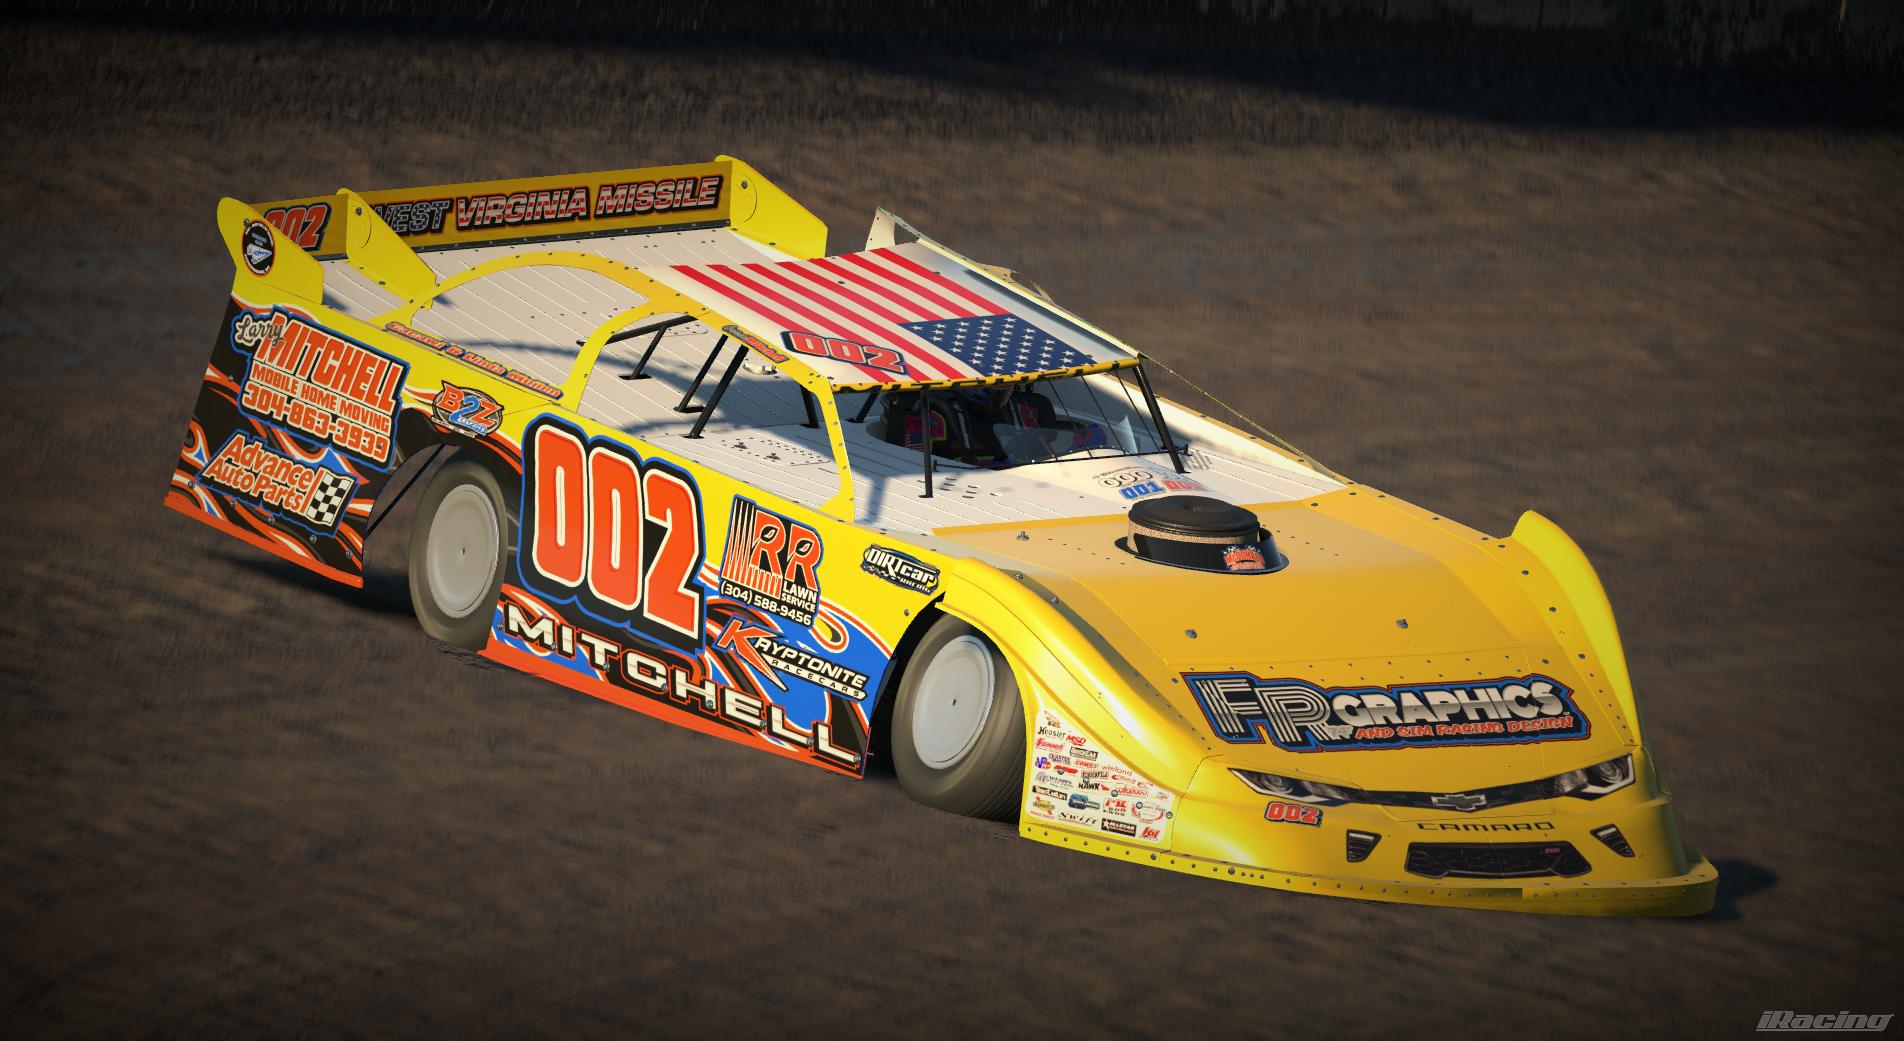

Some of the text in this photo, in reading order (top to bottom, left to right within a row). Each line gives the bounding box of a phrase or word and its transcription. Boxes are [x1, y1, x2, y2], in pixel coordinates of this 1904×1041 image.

[457, 189, 587, 228] VIRGINIA
[595, 177, 719, 215] MISSILE
[236, 315, 285, 347] Larry
[788, 331, 906, 375] 002
[254, 313, 405, 414] MITCHELL
[251, 362, 299, 397] MOBILE
[300, 378, 339, 413] HOME
[339, 391, 392, 434] MOVING
[436, 382, 503, 427] B2Z
[241, 380, 389, 464] 304-863-3939
[222, 435, 314, 489] Advance
[205, 459, 305, 514] Auto Parts
[532, 424, 700, 640] 002
[720, 581, 813, 627] (304) 588-9456
[781, 592, 816, 613] SERVICE
[783, 581, 818, 604] LAWN
[717, 619, 867, 691] KRYPTONITE
[507, 604, 861, 765] MITCHELL
[772, 659, 860, 697] RACECARS
[1332, 682, 1563, 727] GRAPHICS
[1355, 726, 1395, 739] AND
[1396, 725, 1435, 737] SIM
[1436, 721, 1505, 736] RACING
[1506, 715, 1574, 732] DESIGN
[1266, 802, 1320, 825] 002
[1417, 822, 1556, 832] CAMARO
